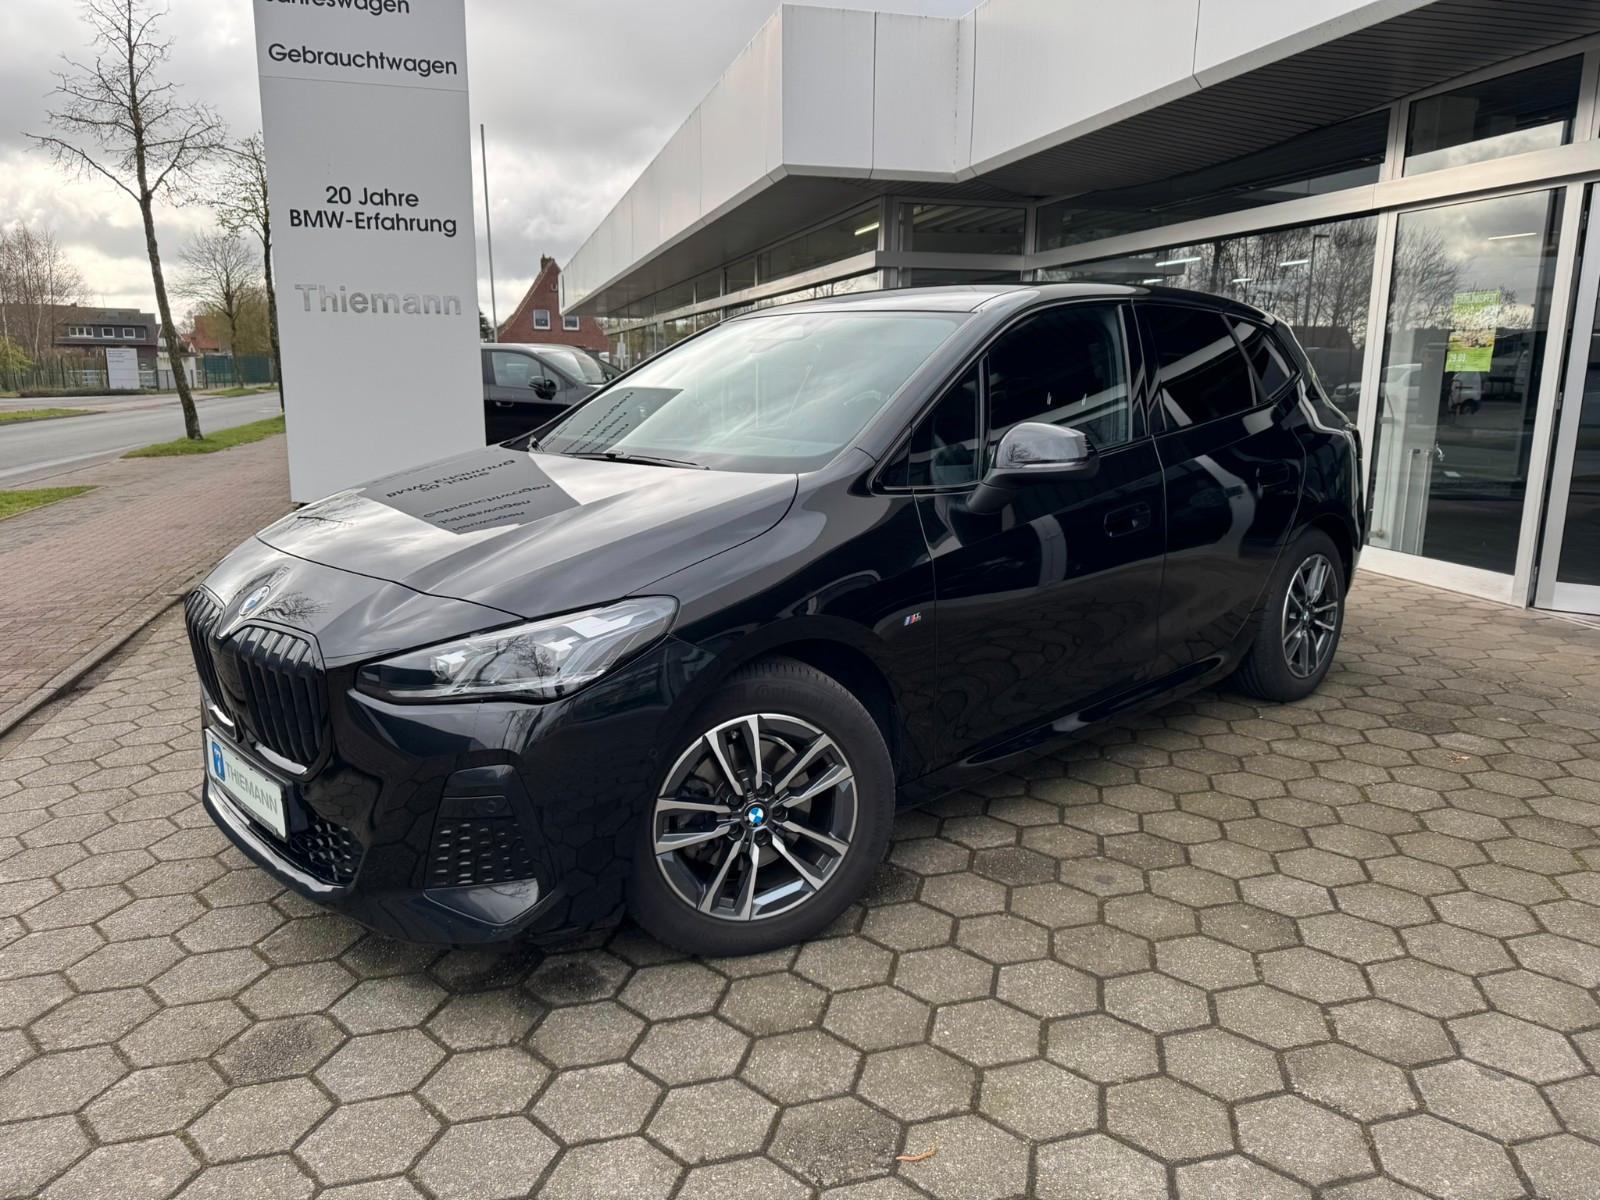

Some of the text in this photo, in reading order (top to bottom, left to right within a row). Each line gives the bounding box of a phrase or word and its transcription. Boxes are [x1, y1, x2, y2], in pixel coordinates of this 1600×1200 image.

[266, 0, 410, 16] eswagen
[268, 43, 457, 77] Gebrauchtwagen
[325, 186, 419, 208] 20 Jahre
[289, 208, 457, 238] BMW-Erfahrung
[294, 284, 462, 316] Thiemann
[225, 760, 279, 815] THIEMANN
